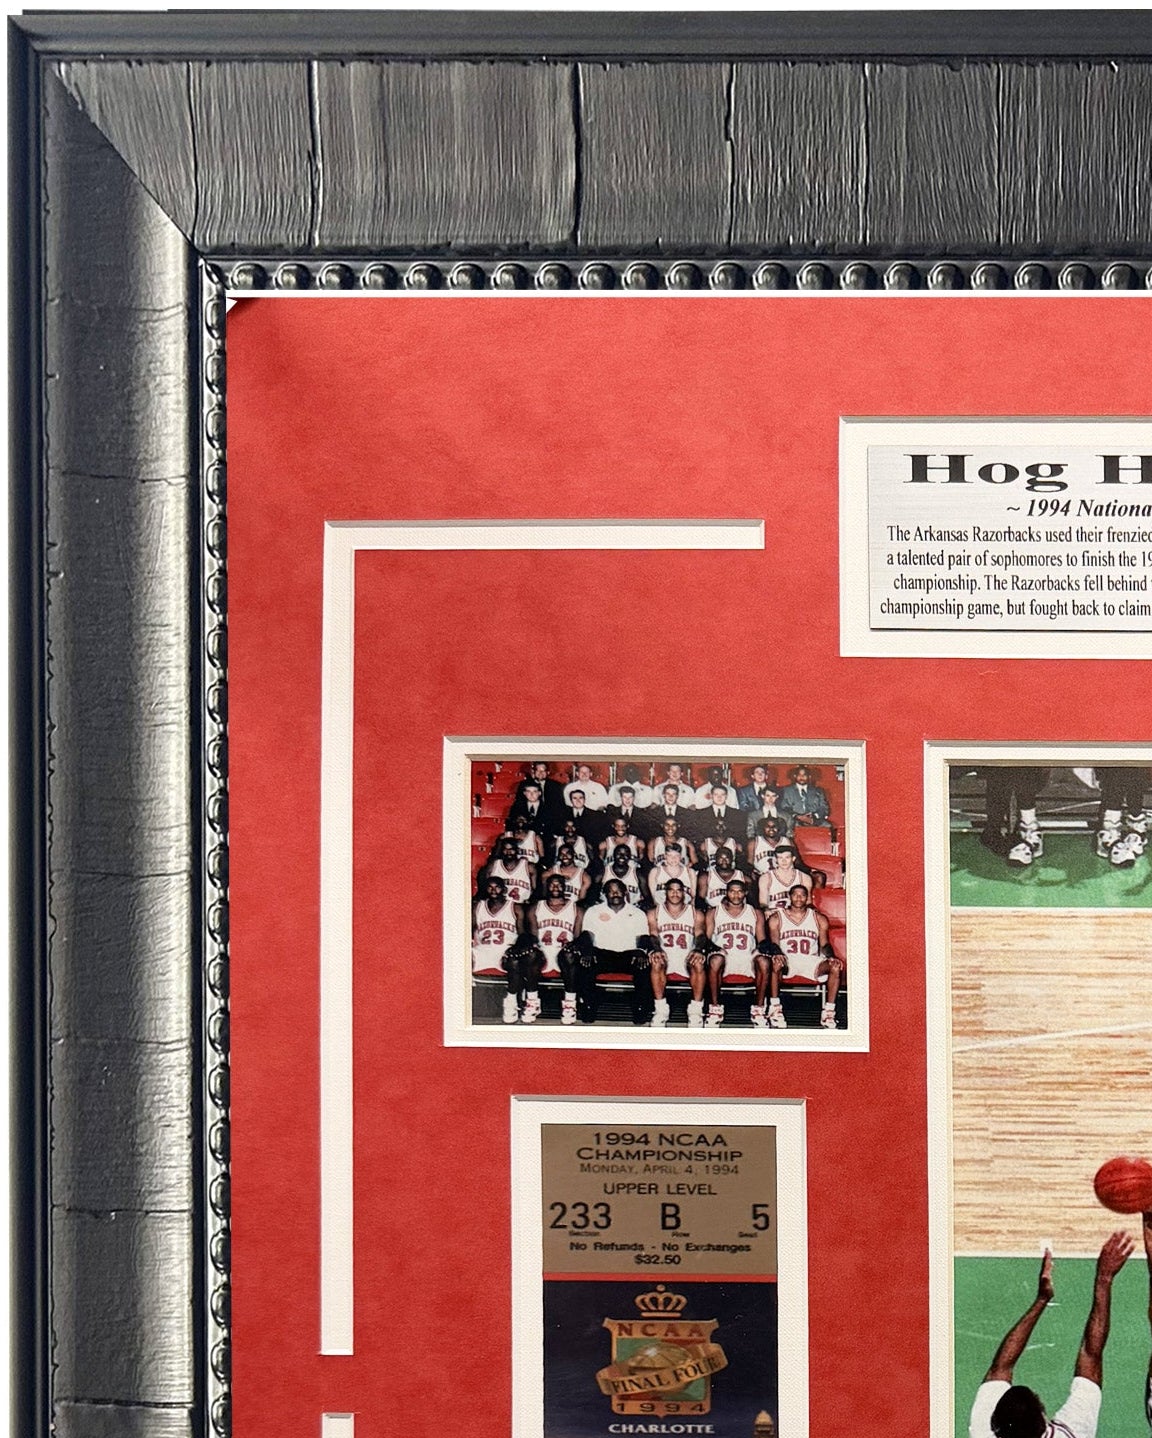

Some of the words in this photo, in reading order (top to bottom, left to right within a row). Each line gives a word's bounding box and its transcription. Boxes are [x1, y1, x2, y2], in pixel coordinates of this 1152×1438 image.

[904, 453, 1068, 493] Hog
[1027, 498, 1071, 517] 1994
[887, 524, 910, 542] The
[914, 524, 968, 542] Arkansas
[973, 525, 1041, 543] Razorbacks
[1046, 525, 1072, 543] used
[1076, 525, 1103, 543] their
[887, 553, 894, 566] a
[897, 548, 944, 566] talented
[948, 548, 971, 571] pair
[974, 548, 989, 567] of
[991, 553, 1062, 571] sophomores
[1066, 552, 1077, 567] to
[1082, 550, 1115, 567] finish
[1119, 550, 1136, 568] the
[894, 573, 980, 595] championship.
[984, 574, 1007, 591] The
[1012, 574, 1080, 592] Razorbacks
[1084, 574, 1103, 592] fell
[1108, 574, 1147, 592] behind
[881, 597, 963, 620] championship
[968, 603, 1003, 620] game,
[1007, 598, 1025, 616] but
[1030, 598, 1068, 621] fought
[1072, 599, 1099, 616] back
[1104, 601, 1115, 617] to
[1119, 599, 1151, 617] claim
[481, 929, 505, 945] 23
[542, 930, 568, 947] 44
[663, 933, 687, 949] 34
[722, 933, 748, 950] 33
[787, 939, 811, 955] 30
[594, 1133, 649, 1145] 1994
[658, 1133, 727, 1146] NCAA
[577, 1148, 742, 1161] CHAMPIONSHIP
[705, 1165, 739, 1175] 1994
[603, 1183, 659, 1195] UPPER
[667, 1184, 717, 1195] LEVEL
[549, 1202, 611, 1229] 233
[661, 1203, 681, 1230] B
[752, 1204, 769, 1230] 5
[570, 1242, 587, 1250] No
[594, 1242, 644, 1251] Refunds
[662, 1243, 679, 1251] No
[686, 1243, 751, 1254] Exchanges
[635, 1254, 681, 1265] $32.50
[618, 1323, 704, 1337] NCAA
[611, 1374, 670, 1393] FINAL
[673, 1357, 720, 1382] FOUR
[617, 1403, 705, 1412] 1994
[608, 1424, 715, 1434] CHARLOTTE
